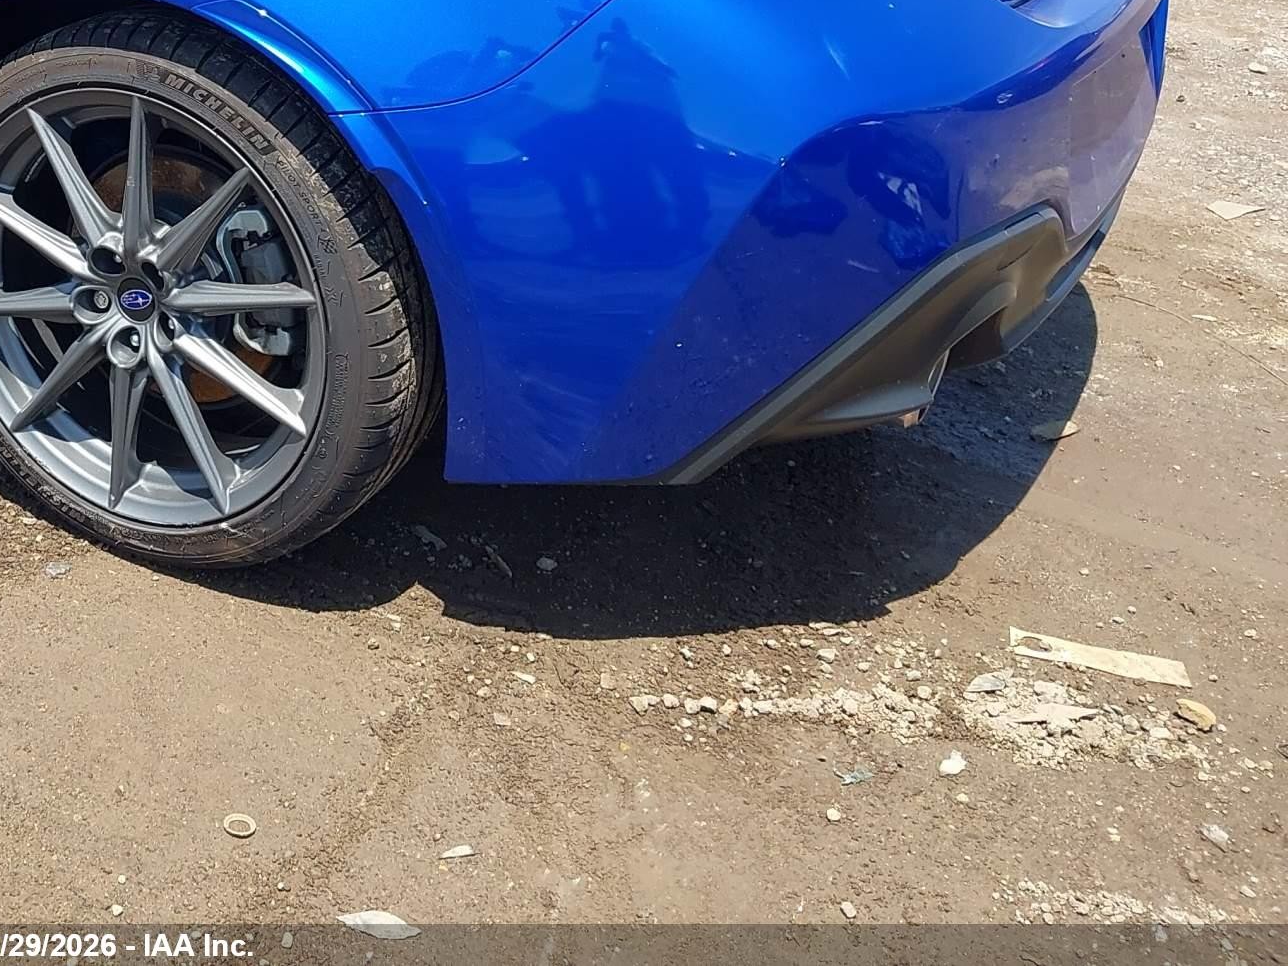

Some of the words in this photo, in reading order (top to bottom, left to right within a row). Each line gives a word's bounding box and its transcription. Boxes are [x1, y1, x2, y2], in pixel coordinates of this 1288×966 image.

[164, 73, 273, 156] MICHELIN
[276, 159, 301, 189] PILOT
[298, 191, 324, 227] SPORT
